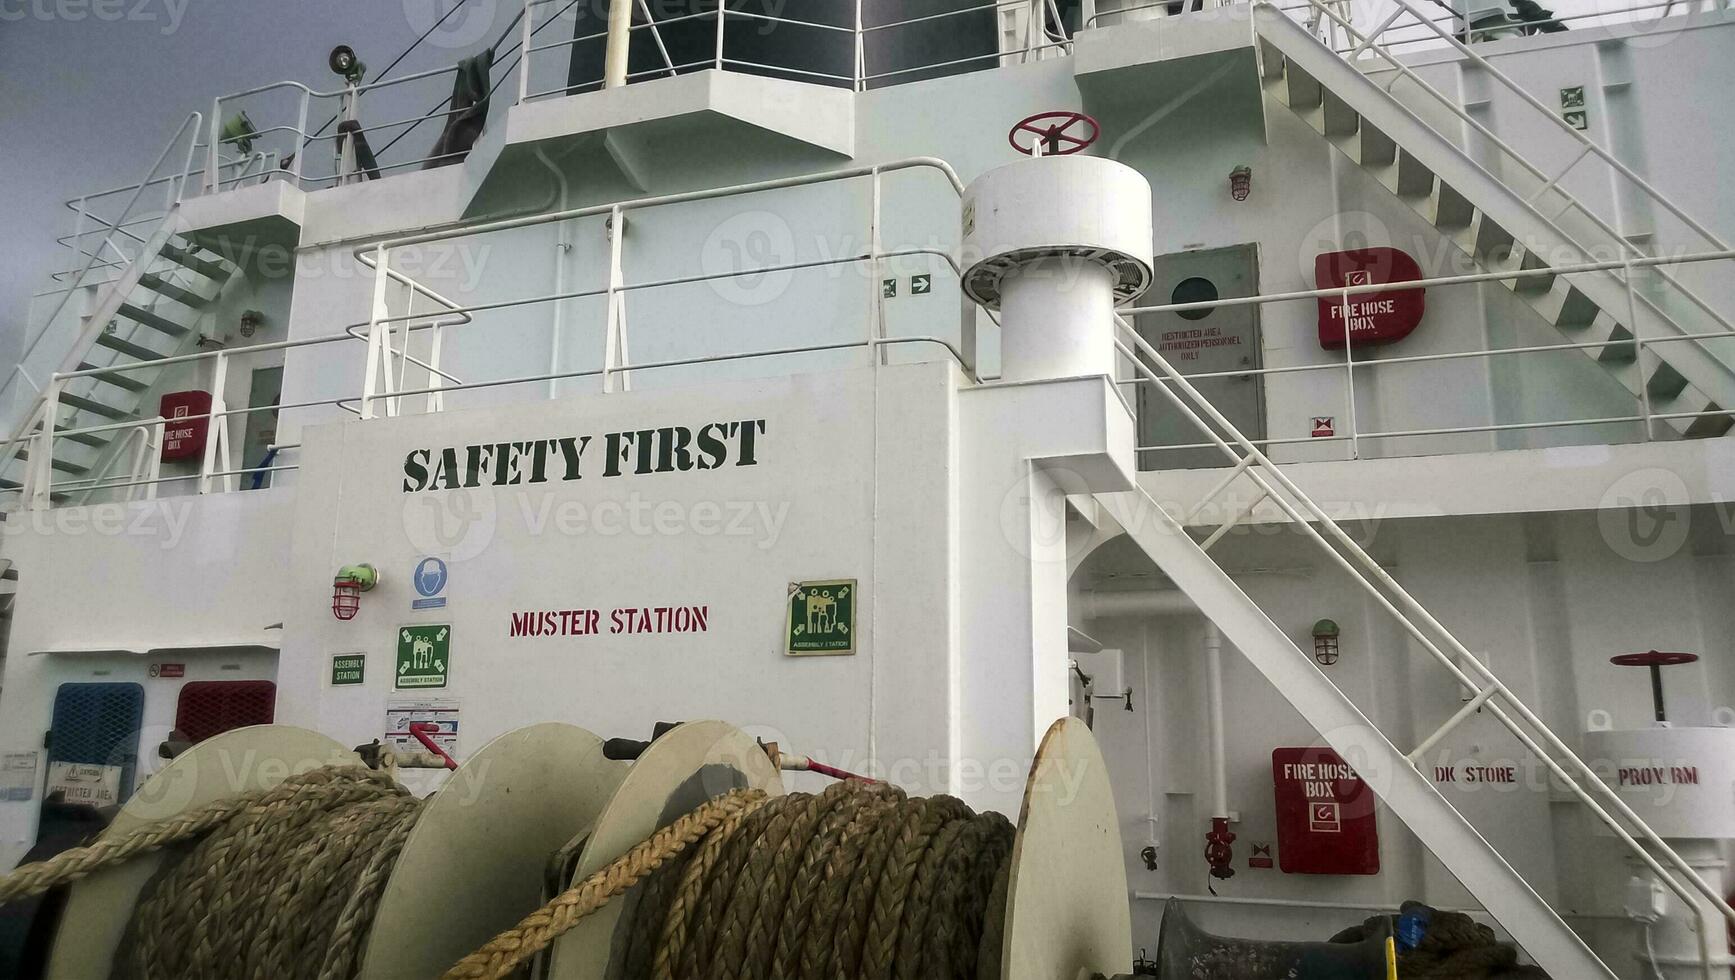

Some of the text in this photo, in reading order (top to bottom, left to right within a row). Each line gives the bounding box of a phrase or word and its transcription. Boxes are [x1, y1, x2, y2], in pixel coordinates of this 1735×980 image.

[1361, 300, 1394, 315] HOSE
[1350, 316, 1375, 331] BOX
[1162, 330, 1201, 341] RESTRICTED
[403, 419, 765, 493] SAFETY FIRST
[510, 606, 708, 637] MUSTER STATION
[334, 660, 364, 669] ASSEMBLY
[336, 671, 361, 680] STATION
[424, 675, 443, 683] STATION
[1284, 763, 1357, 779] FIRE HOSE
[1434, 767, 1515, 782] DK STORE
[1671, 767, 1698, 784] RM
[1305, 781, 1335, 797] BOX
